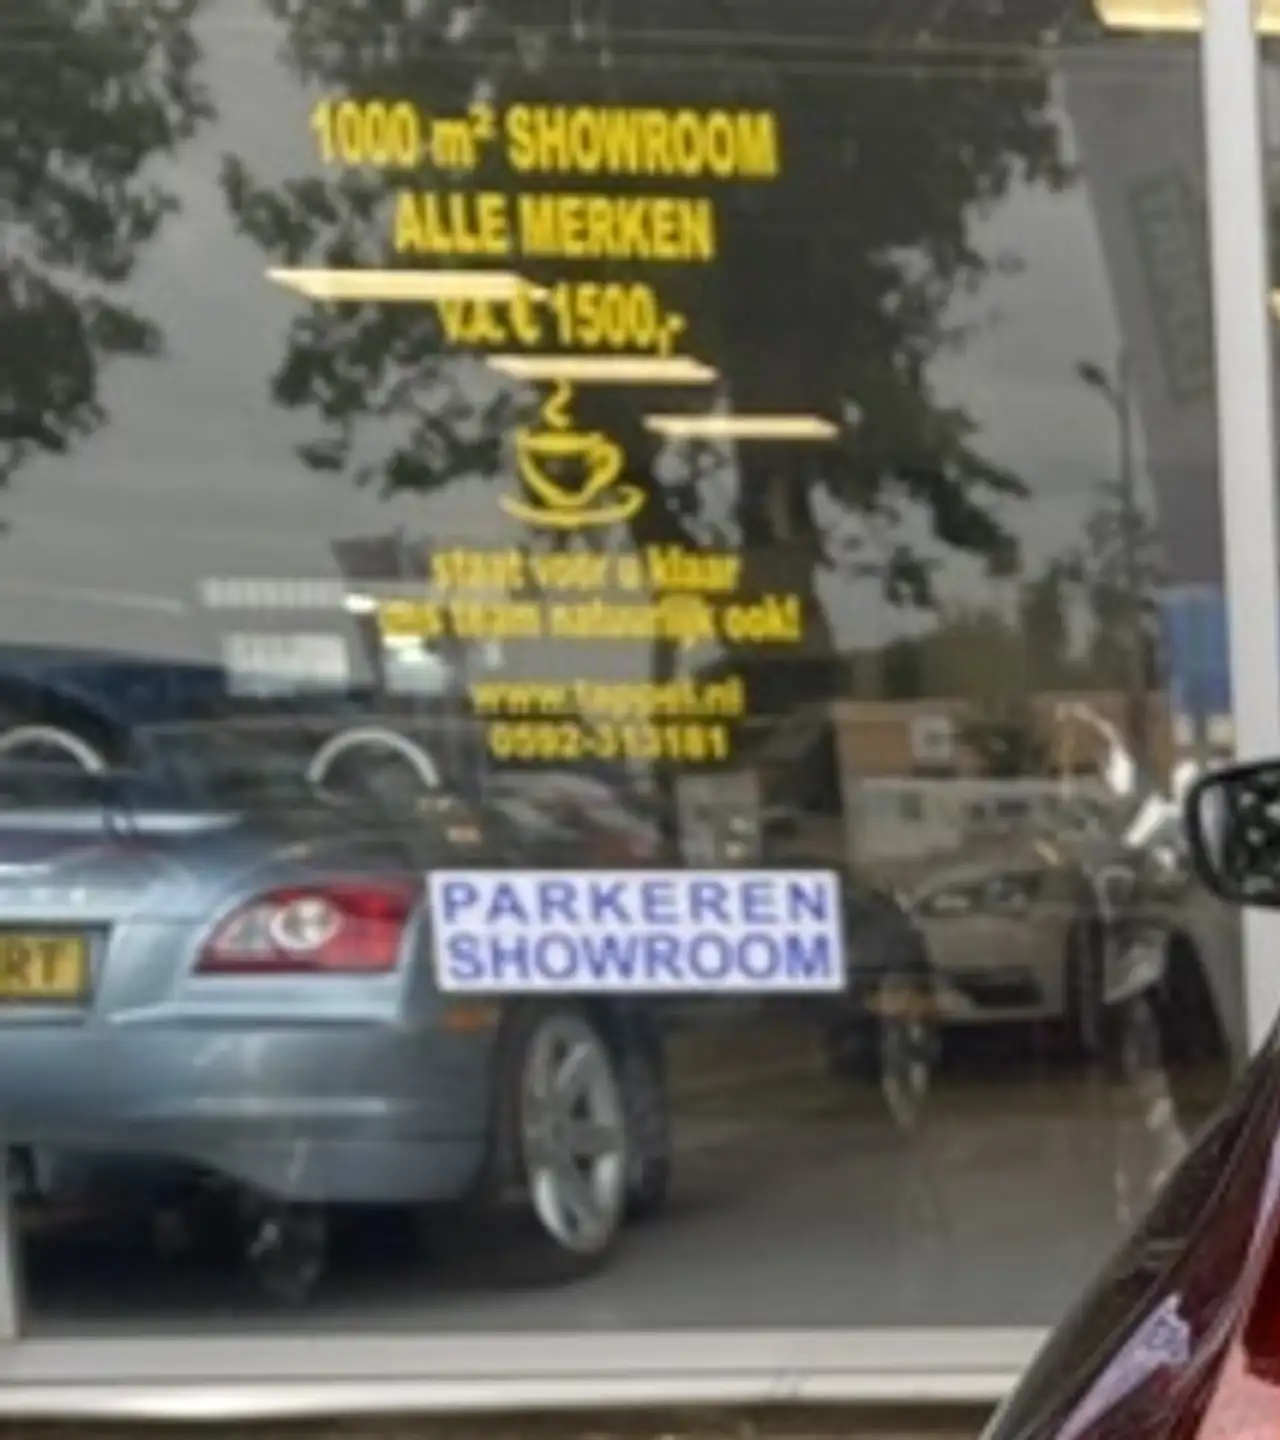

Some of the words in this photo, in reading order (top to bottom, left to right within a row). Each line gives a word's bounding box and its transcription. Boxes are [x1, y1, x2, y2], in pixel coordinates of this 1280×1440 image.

[311, 98, 421, 166] 1000
[507, 105, 780, 177] SHOWROOM
[394, 190, 508, 254] ALLE
[515, 194, 718, 260] MERKEN
[648, 544, 742, 590] klaar
[441, 880, 829, 926] PARKEREN
[447, 931, 833, 979] SHOWROOM
